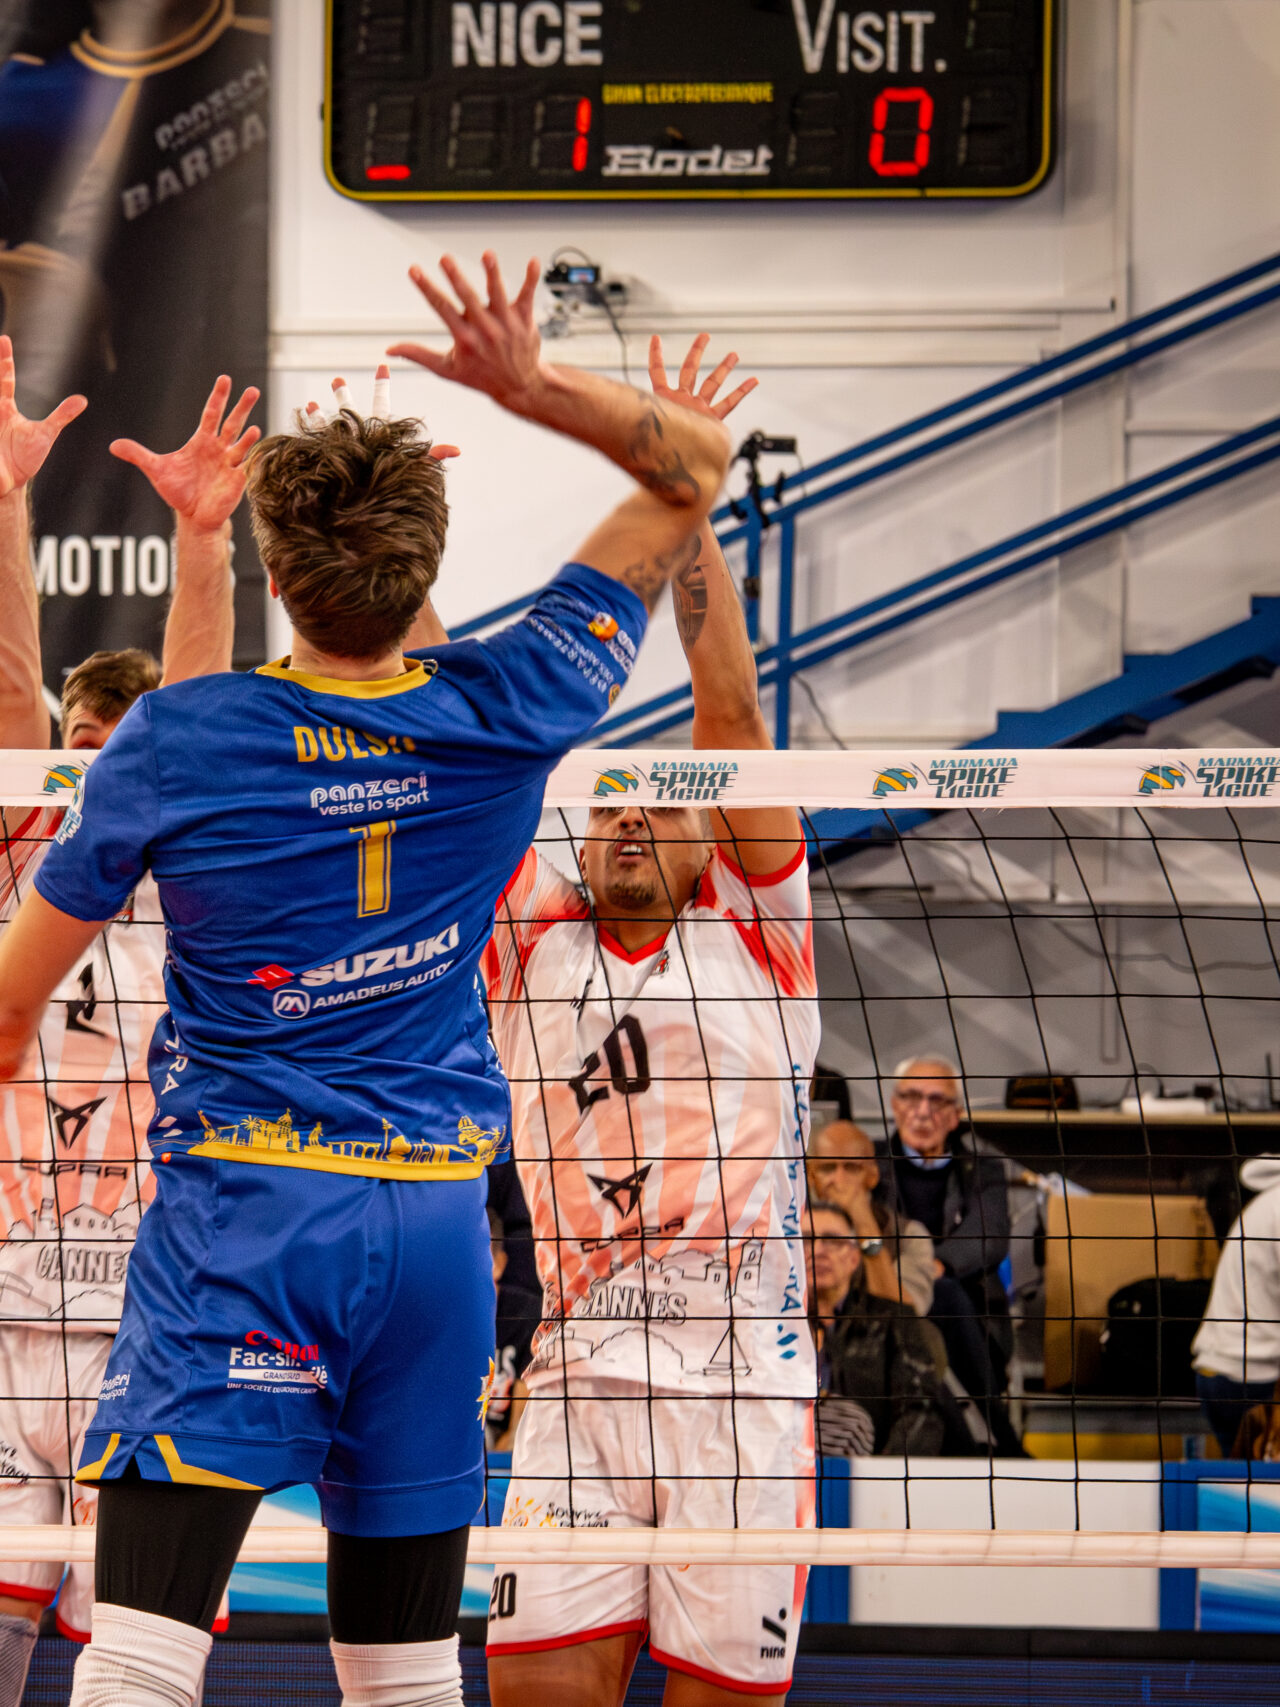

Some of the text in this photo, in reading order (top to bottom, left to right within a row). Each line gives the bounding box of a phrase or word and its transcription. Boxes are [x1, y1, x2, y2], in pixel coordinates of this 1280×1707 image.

[451, 1, 604, 68] NICE
[571, 97, 592, 172] 1
[869, 86, 934, 177] 0
[122, 112, 267, 221] BARBA
[601, 143, 774, 177] Bodet
[29, 535, 236, 598] MOTIO
[293, 725, 417, 763] DULS
[651, 761, 739, 772] MARMARA
[928, 767, 1018, 789] SPIKE
[930, 757, 1018, 769] MARMARA
[1197, 766, 1280, 787] SPIKE
[310, 770, 427, 808] panzeri
[649, 771, 738, 791] SPIKE
[656, 787, 726, 800] LIGUE
[936, 783, 1007, 798] LIGUE
[1203, 783, 1275, 797] LIGUE
[319, 789, 430, 816] veste lo sport
[348, 819, 397, 918] 1
[299, 921, 460, 987] SUZUKI
[312, 979, 404, 1009] AMADEUS
[35, 1244, 130, 1285] CANNE
[760, 1646, 786, 1659] nine
